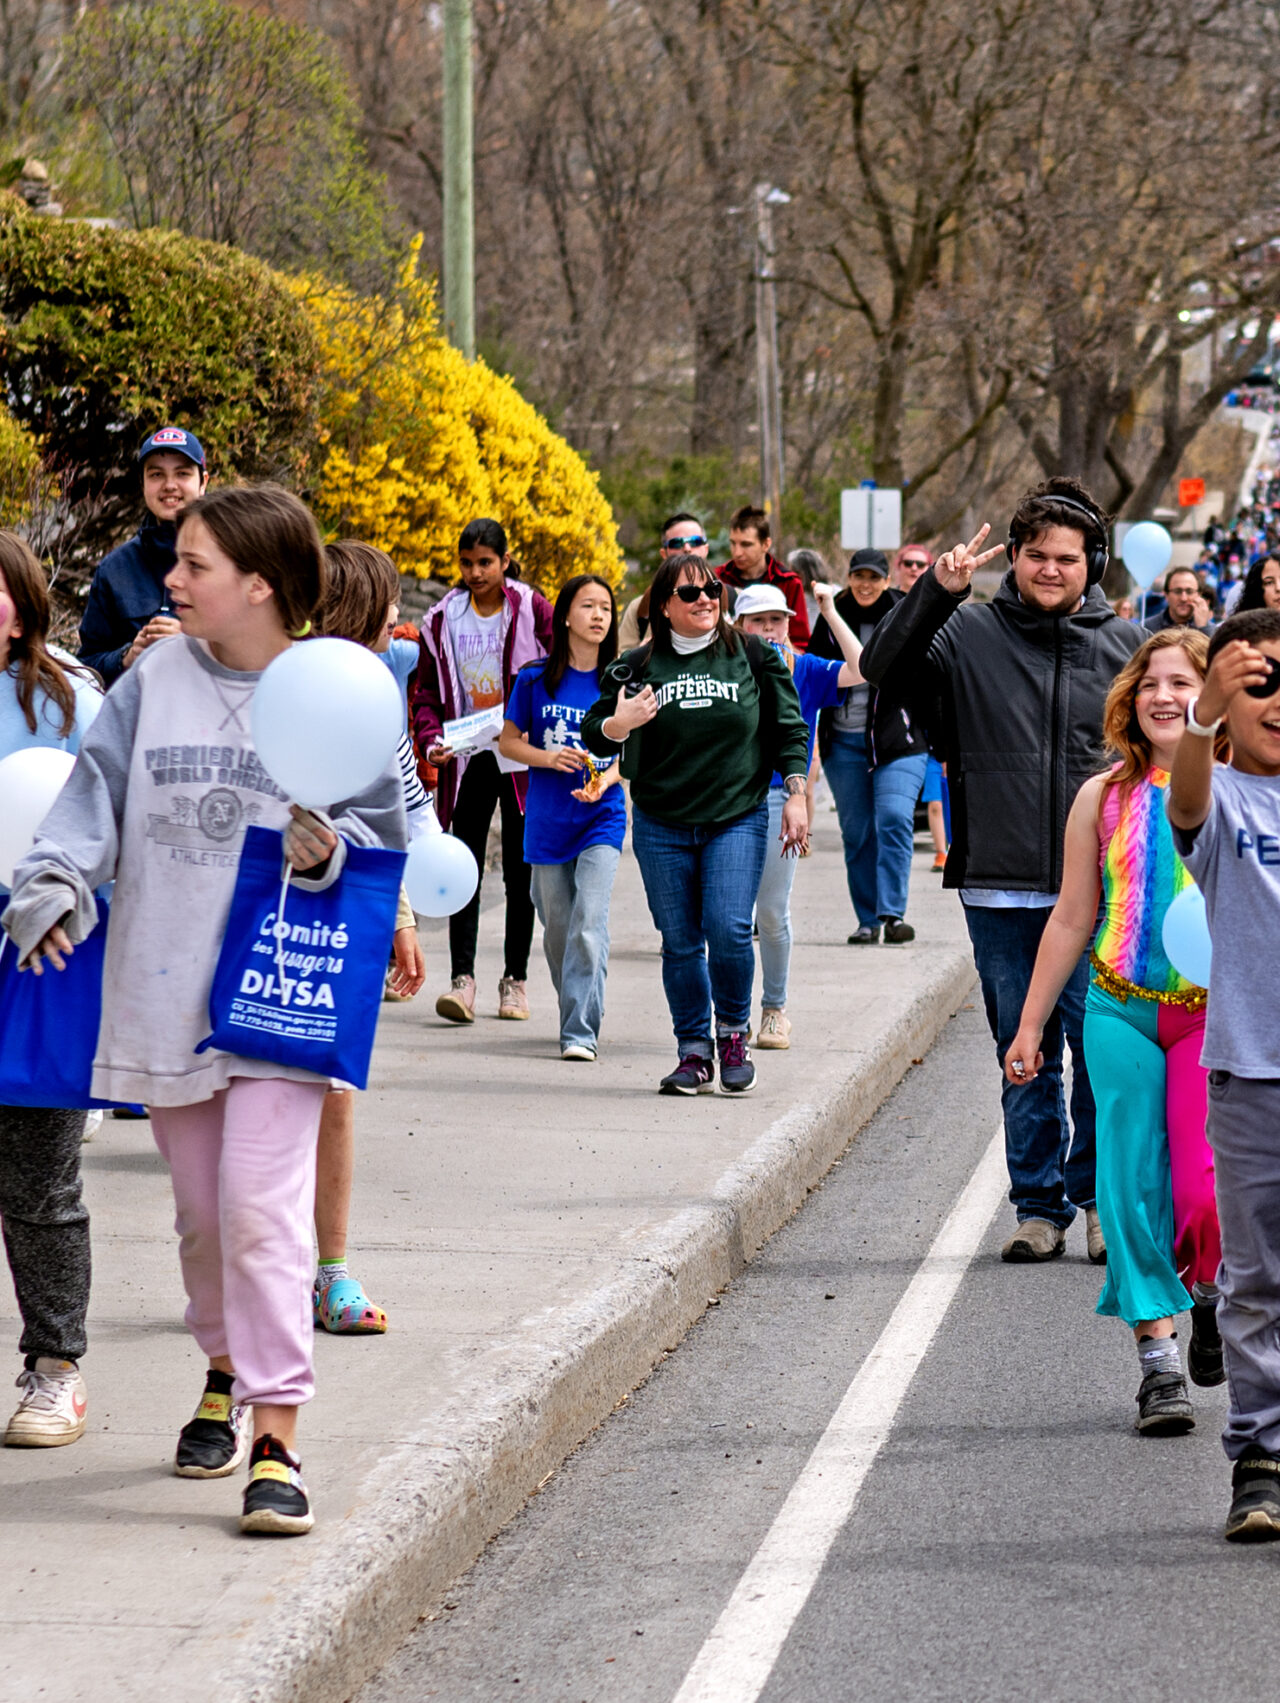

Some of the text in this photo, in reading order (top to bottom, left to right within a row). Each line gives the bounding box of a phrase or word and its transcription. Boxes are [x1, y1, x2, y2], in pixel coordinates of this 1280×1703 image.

[145, 745, 233, 771] PREMIER
[259, 912, 350, 950] Comité
[251, 940, 274, 955] des
[239, 968, 335, 1009] DI-TSA
